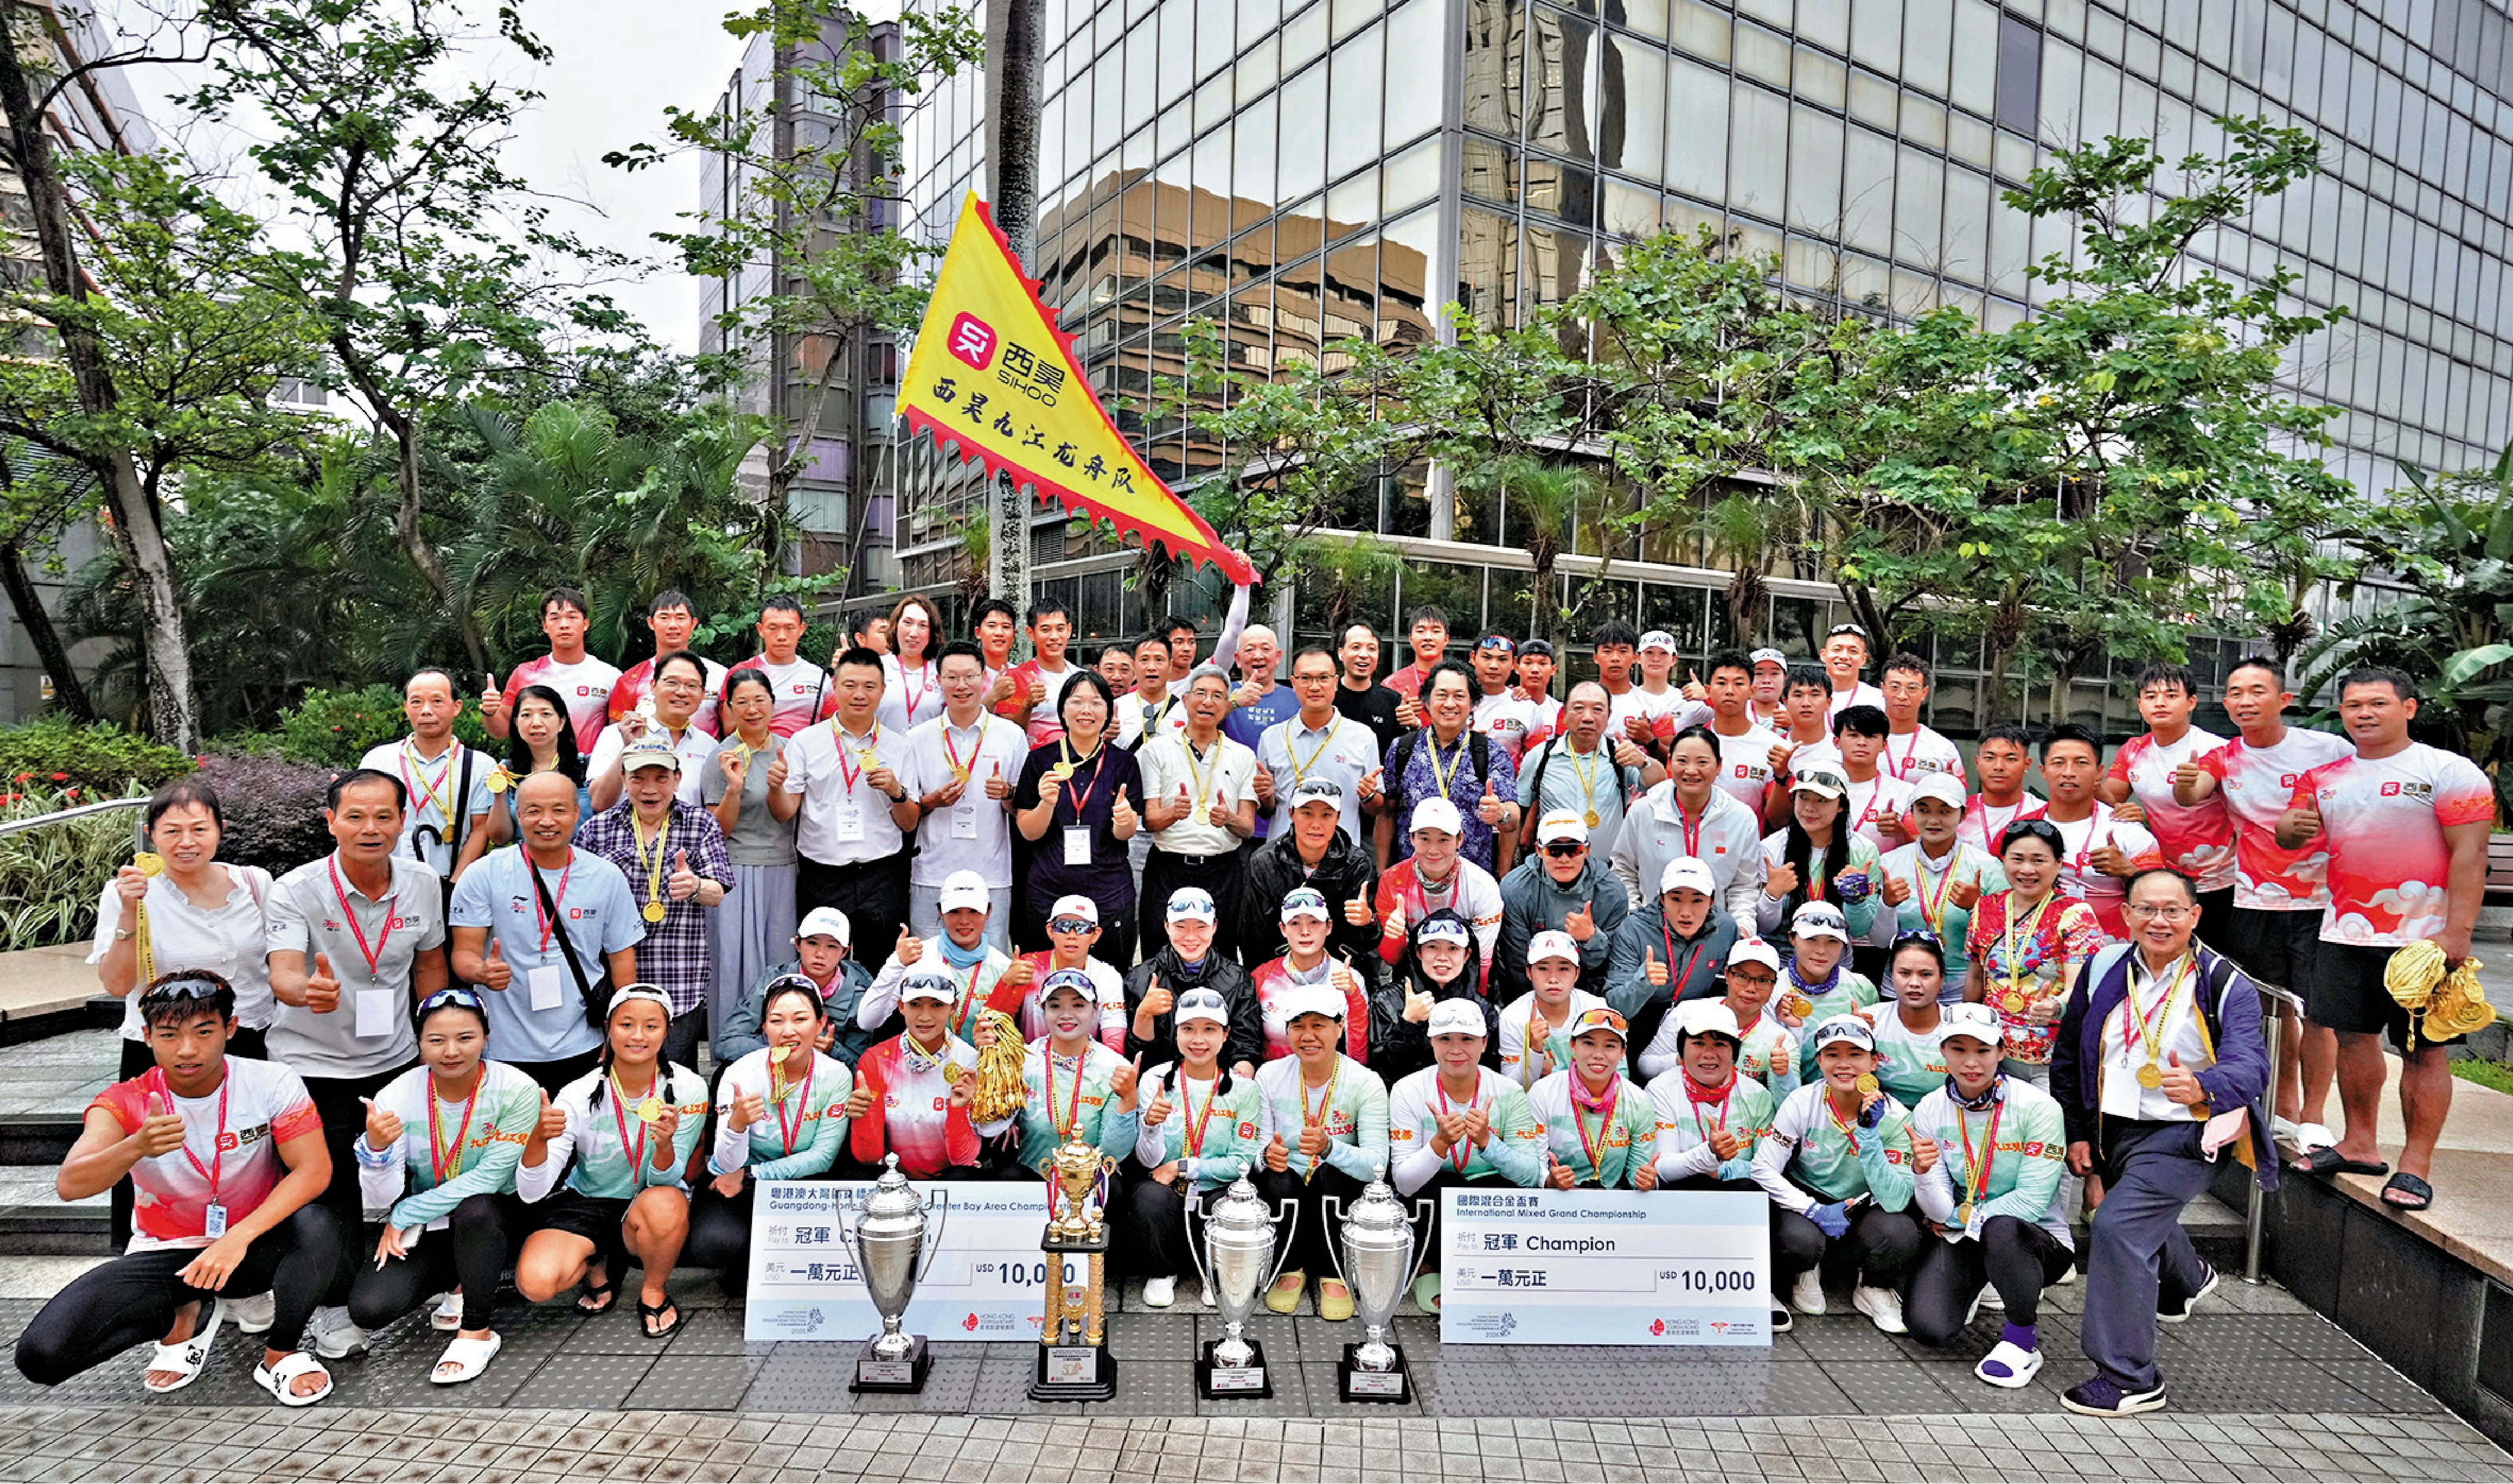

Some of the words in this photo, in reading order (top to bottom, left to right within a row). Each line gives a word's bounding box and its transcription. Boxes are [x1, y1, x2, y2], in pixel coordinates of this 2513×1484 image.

[1002, 342, 1065, 395] 西昊
[997, 369, 1057, 408] SIHOO
[933, 377, 1135, 494] 西昊九江龙舟队
[964, 1202, 980, 1212] Bay
[985, 1202, 1007, 1210] Area
[1457, 1208, 1515, 1217] International
[1517, 1209, 1546, 1217] Mixed
[1549, 1209, 1578, 1217] Grand
[1580, 1209, 1647, 1219] Championship
[795, 1227, 830, 1244] 冠軍
[1484, 1234, 1518, 1250] 冠軍
[1526, 1235, 1616, 1254] Champion
[790, 1263, 859, 1281] 一萬元正
[976, 1263, 995, 1272] USD
[999, 1263, 1076, 1287] 10,00
[1659, 1271, 1677, 1280] USD
[1481, 1269, 1547, 1287] 一萬元正
[1682, 1270, 1755, 1294] 10,000
